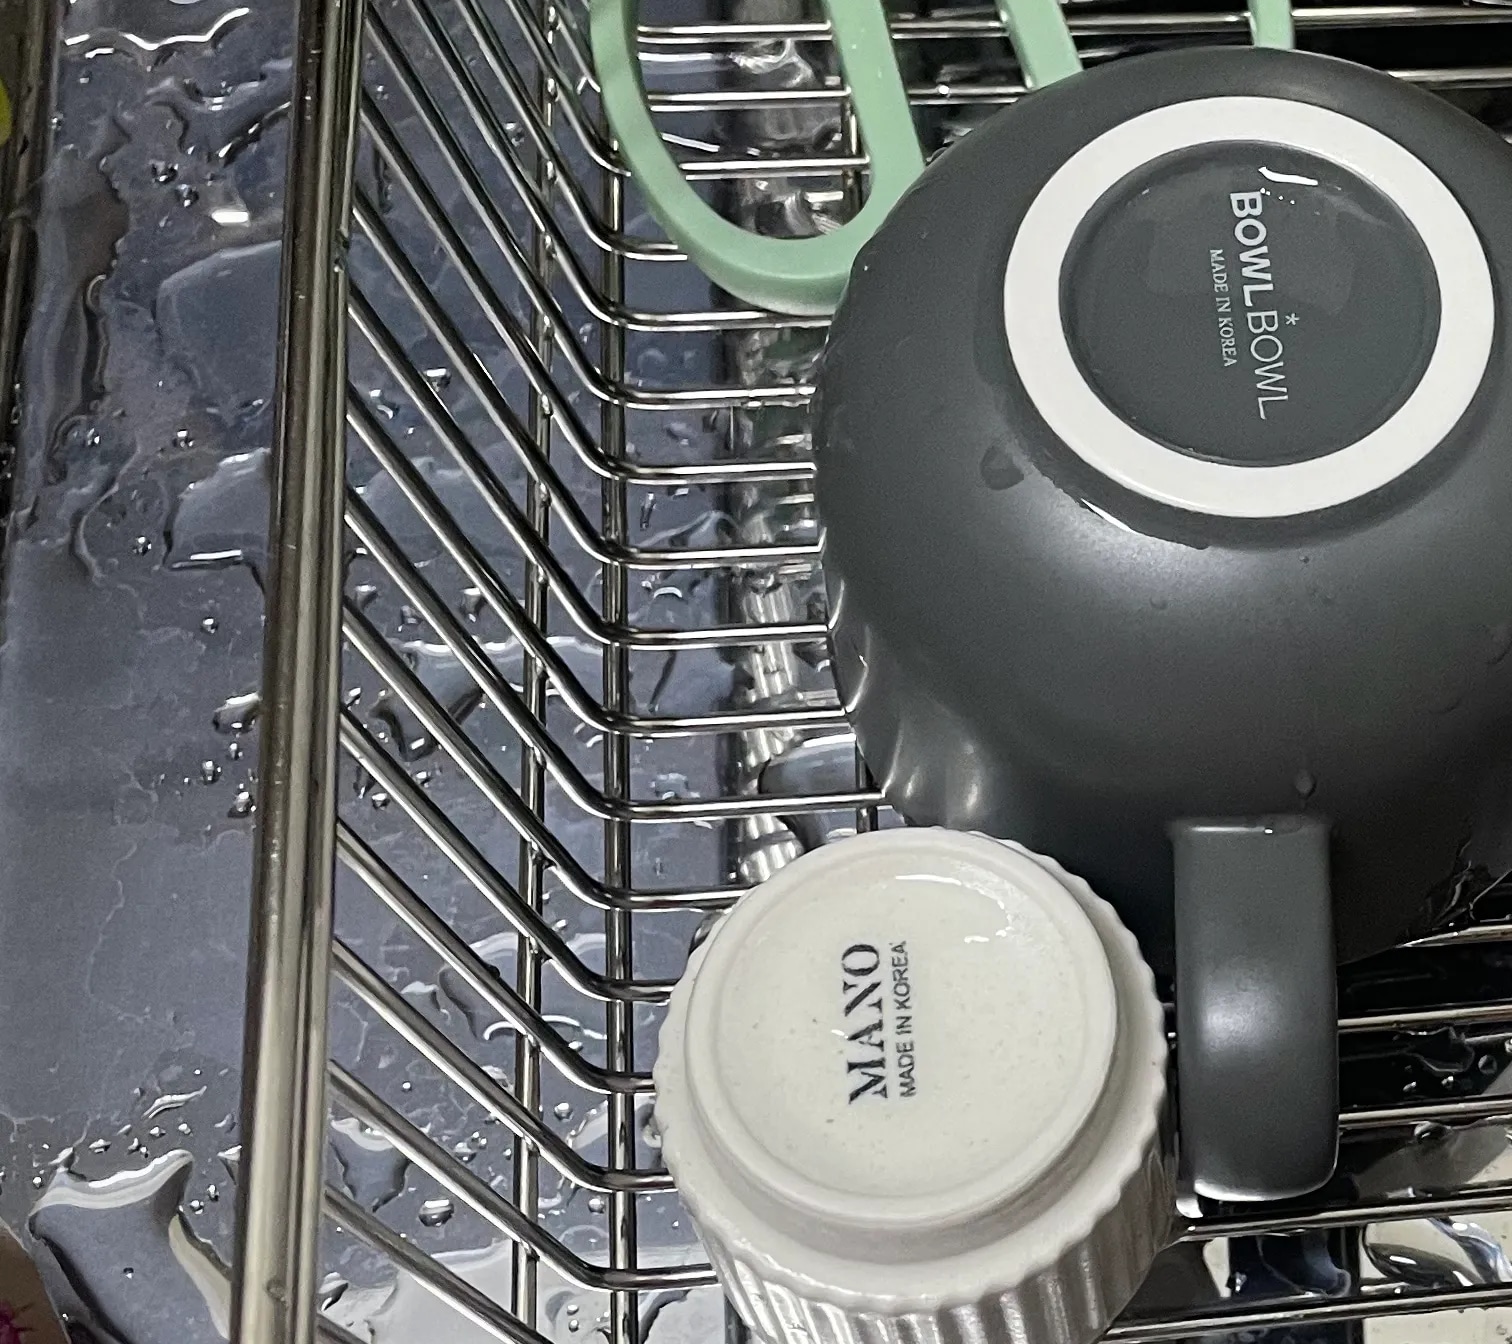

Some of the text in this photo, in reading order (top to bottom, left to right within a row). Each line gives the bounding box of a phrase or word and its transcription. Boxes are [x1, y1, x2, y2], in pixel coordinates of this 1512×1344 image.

[1210, 249, 1237, 367] MADE IN KOREA
[841, 944, 888, 1105] MANO
[889, 940, 917, 1098] MADE IN KOREA
